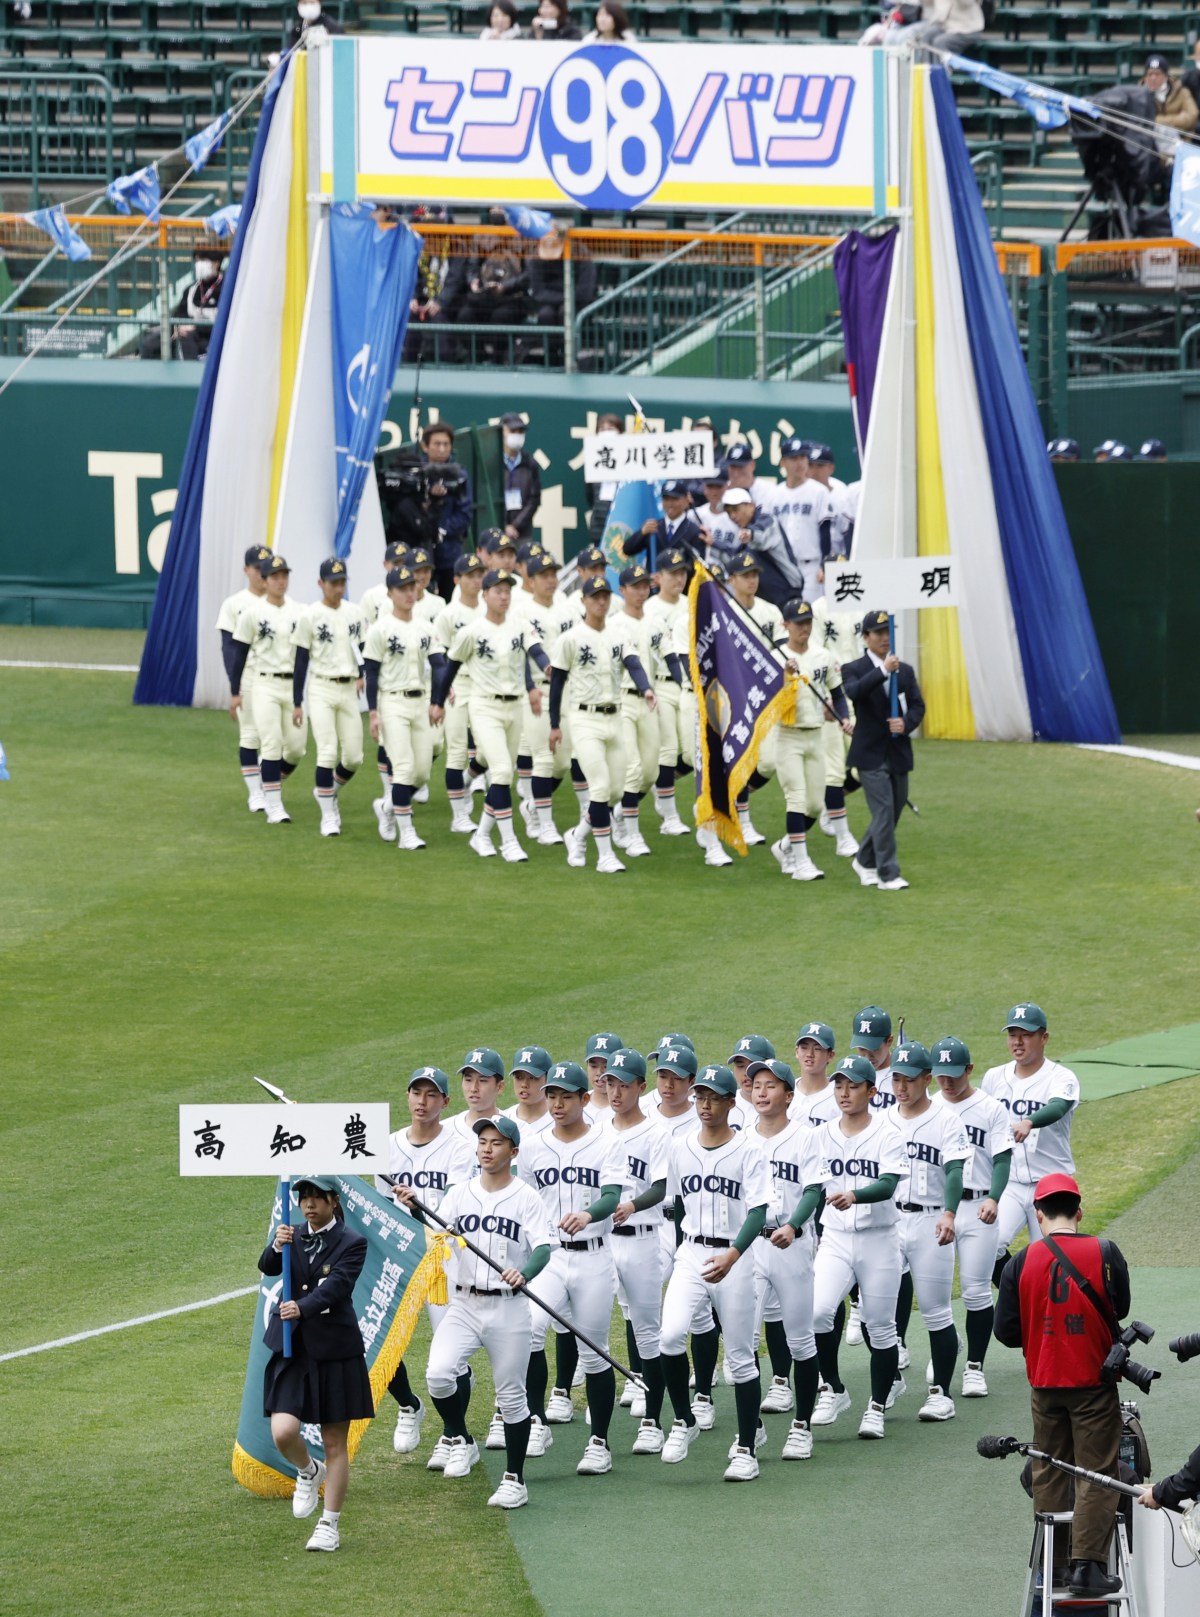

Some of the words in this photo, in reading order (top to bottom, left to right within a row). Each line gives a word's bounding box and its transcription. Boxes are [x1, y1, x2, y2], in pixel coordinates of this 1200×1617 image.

[594, 443, 705, 470] 高川学園
[834, 566, 951, 602] 英明
[317, 621, 362, 644] 英明
[387, 635, 432, 656] 英明
[477, 632, 526, 660] 英明
[579, 644, 625, 666] 英明
[194, 1112, 377, 1161] 高知農
[533, 1166, 601, 1190] KOCHI
[828, 1158, 879, 1179] OCHI
[681, 1174, 742, 1201] KOCHI
[458, 1213, 522, 1243] KOCHI
